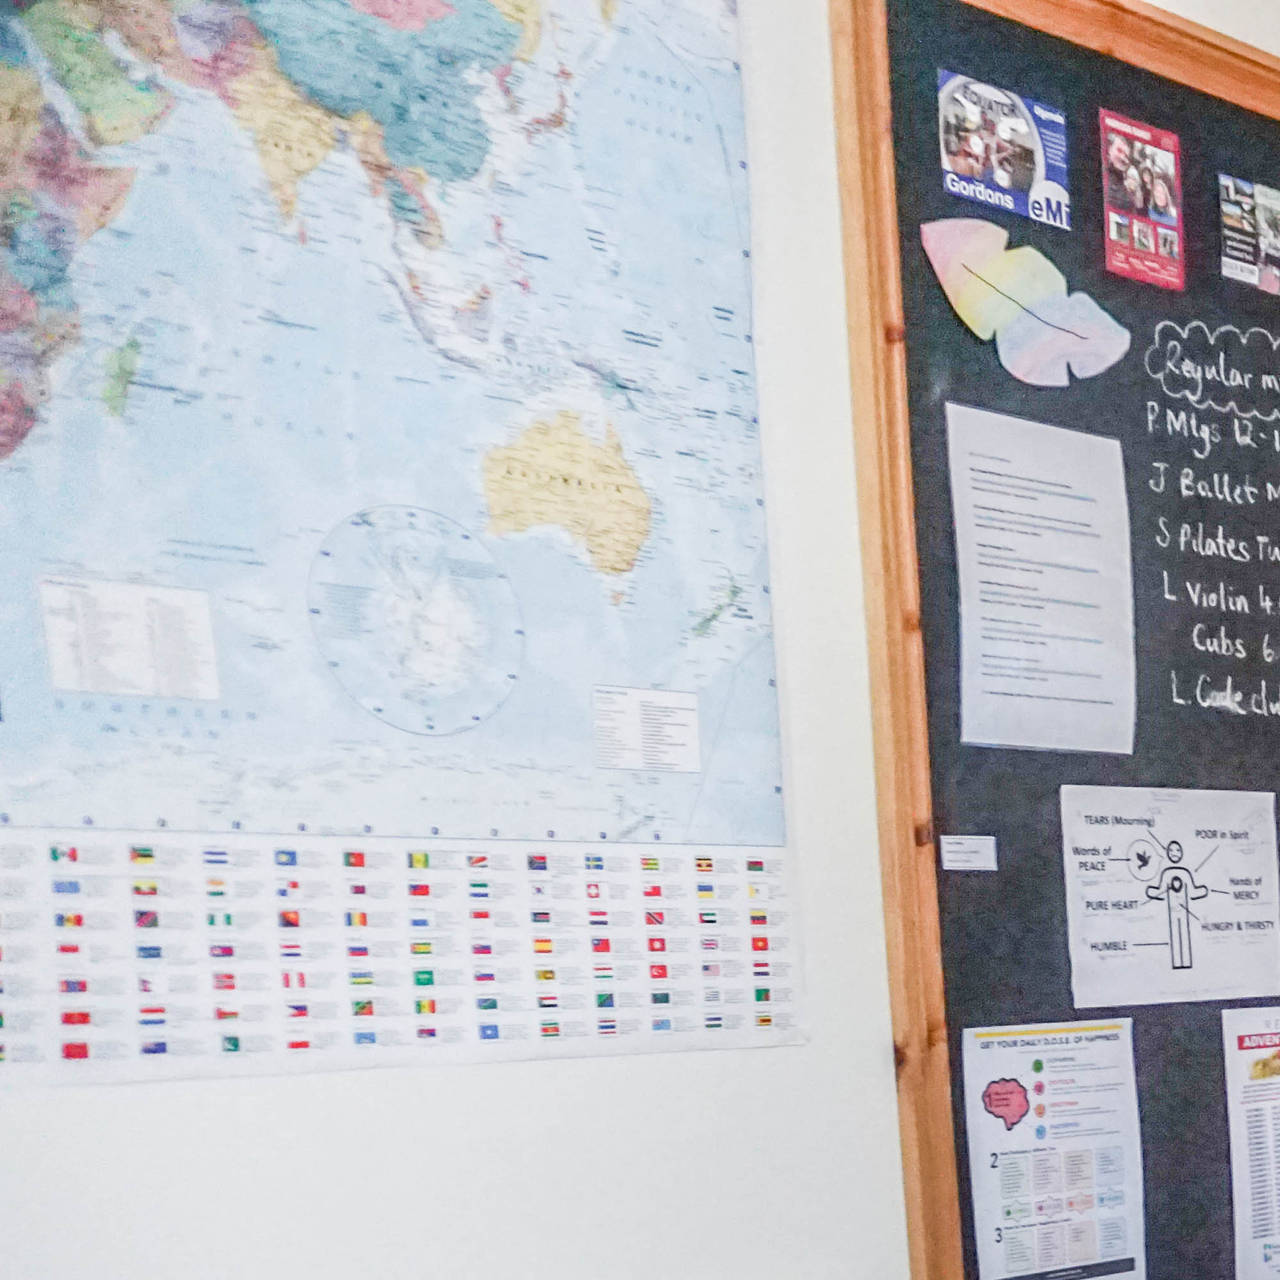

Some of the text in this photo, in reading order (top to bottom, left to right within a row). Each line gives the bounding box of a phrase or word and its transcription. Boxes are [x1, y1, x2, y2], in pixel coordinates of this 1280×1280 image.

[946, 173, 1015, 209] Gordons
[1166, 341, 1251, 400] Regular
[1179, 467, 1257, 504] Ballet
[1179, 522, 1250, 562] Pilates
[1185, 579, 1250, 615] Violin
[1192, 622, 1247, 658] Cubs
[1084, 814, 1110, 826] TEARS
[1071, 845, 1113, 856] Words of
[1078, 861, 1107, 872] PEACE
[1085, 898, 1140, 911] PURE HEART
[1090, 940, 1128, 952] HUMBLE
[989, 1152, 999, 1169] 2
[994, 1226, 1003, 1244] 3
